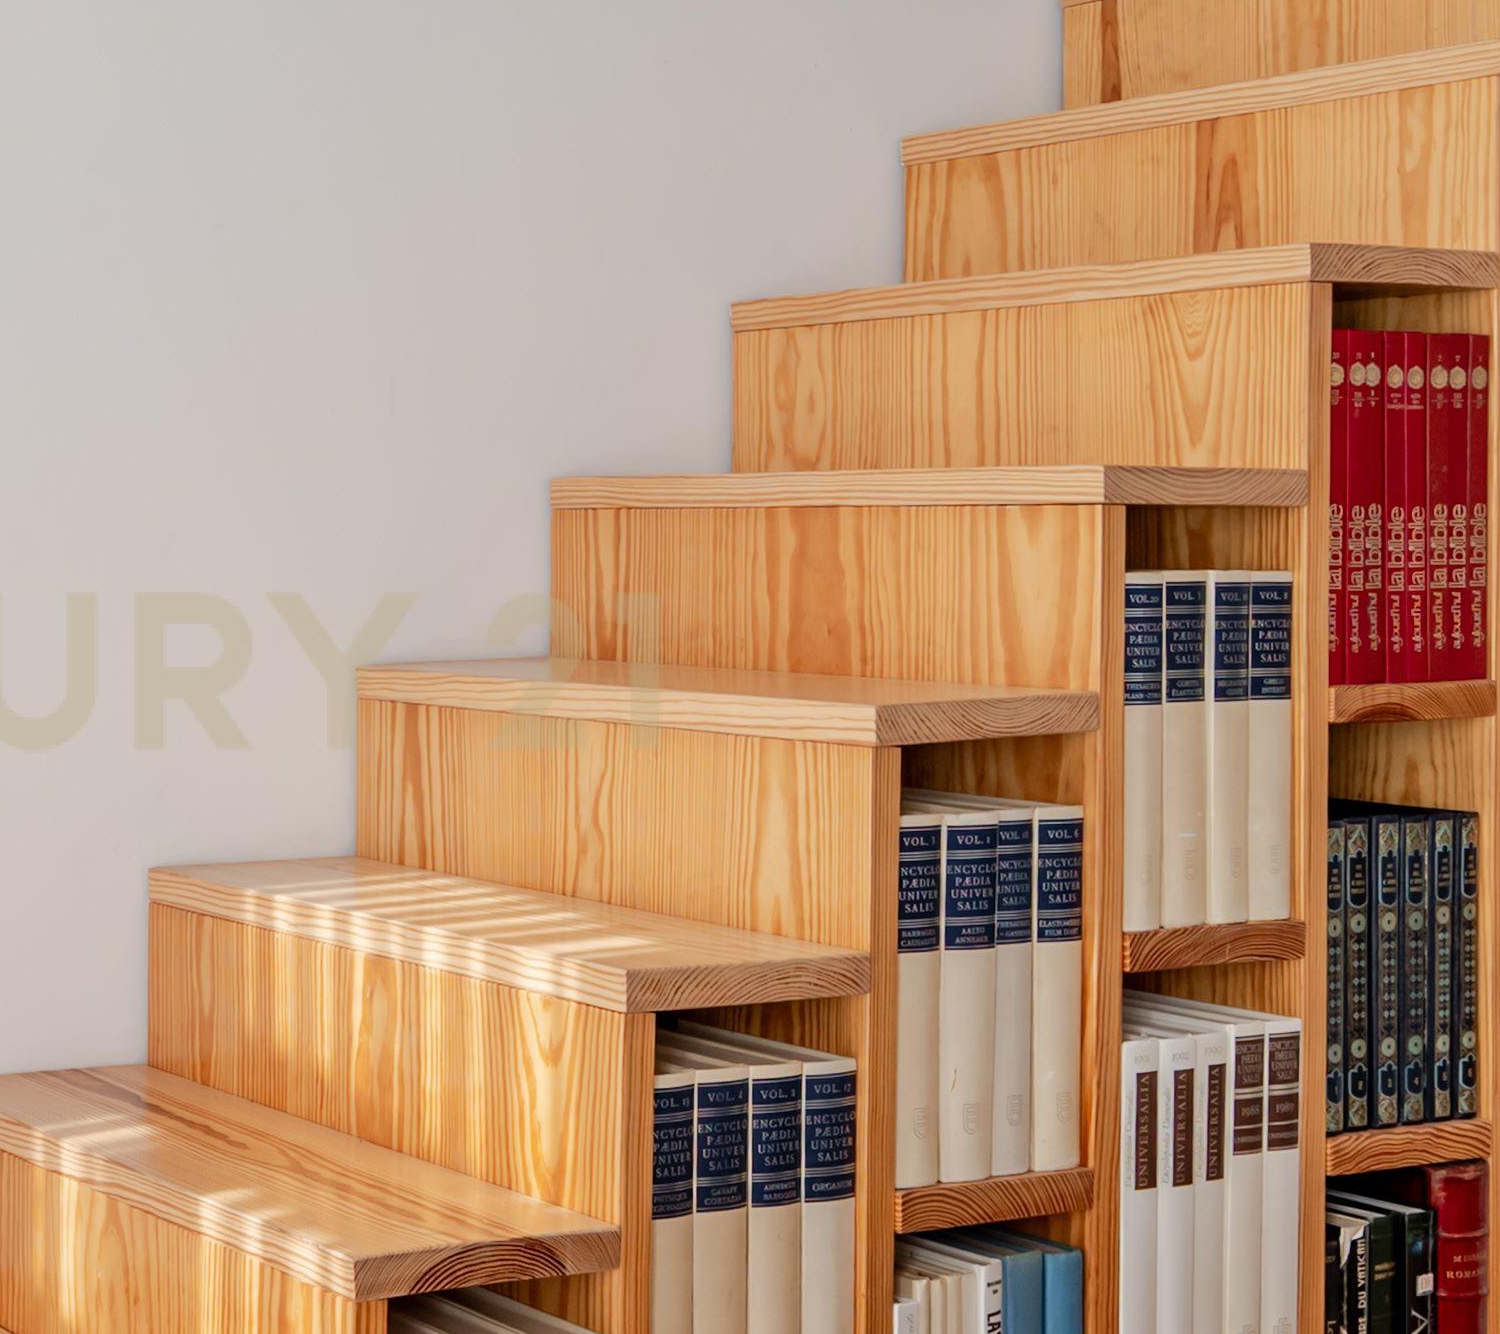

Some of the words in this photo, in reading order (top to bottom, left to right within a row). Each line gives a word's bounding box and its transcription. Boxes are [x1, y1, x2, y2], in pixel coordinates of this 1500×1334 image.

[1348, 505, 1364, 567] bible
[1365, 503, 1381, 565] bible
[1388, 507, 1404, 568] bible
[1408, 506, 1425, 567] bible
[1430, 503, 1448, 565] bible
[1449, 504, 1466, 565] bible
[1470, 503, 1486, 564] bible
[1348, 570, 1363, 591] la
[1365, 568, 1381, 589] la
[1388, 570, 1404, 591] la
[1408, 570, 1425, 590] la
[1430, 568, 1447, 589] la
[1449, 567, 1466, 588] la
[1470, 566, 1486, 587] la
[1215, 620, 1247, 629] ENCYCL
[1127, 646, 1160, 656] UNIVER
[1132, 659, 1156, 667] SALIS
[1176, 655, 1200, 663] SALIS
[1224, 654, 1246, 663] SALIS
[1261, 653, 1287, 662] SALIS
[957, 836, 983, 845] VOL.
[1048, 830, 1072, 839] VOL.
[903, 837, 929, 846] VOL.
[901, 866, 939, 876] NCYCLO
[947, 864, 996, 875] ENCYCLO
[1000, 860, 1031, 870] NCYCLO
[951, 888, 993, 899] UNIVER
[1049, 893, 1076, 903] SALIS
[957, 901, 988, 911] SALIS
[1003, 896, 1026, 906] SALIS
[905, 903, 934, 913] SALIS
[761, 1089, 788, 1099] VOL.
[814, 1084, 840, 1093] VOL.
[708, 1092, 735, 1102] VOL.
[807, 1112, 855, 1125] ENCYCLO
[1209, 1067, 1220, 1177] UNIVERSALIA
[654, 1126, 693, 1139] NCYCLO
[1138, 1075, 1150, 1187] UNIVERSALIA
[1176, 1073, 1188, 1184] UNIVERSALIA
[811, 1137, 853, 1150] UNIVER
[703, 1145, 745, 1159] UNIVER
[818, 1151, 849, 1162] SALIS
[709, 1159, 740, 1171] SALIS
[765, 1155, 795, 1166] SALIS
[656, 1166, 686, 1178] SALIS
[1357, 1239, 1366, 1287] VATICAN
[1358, 1293, 1366, 1309] DU
[1327, 1320, 1336, 1334] Le
